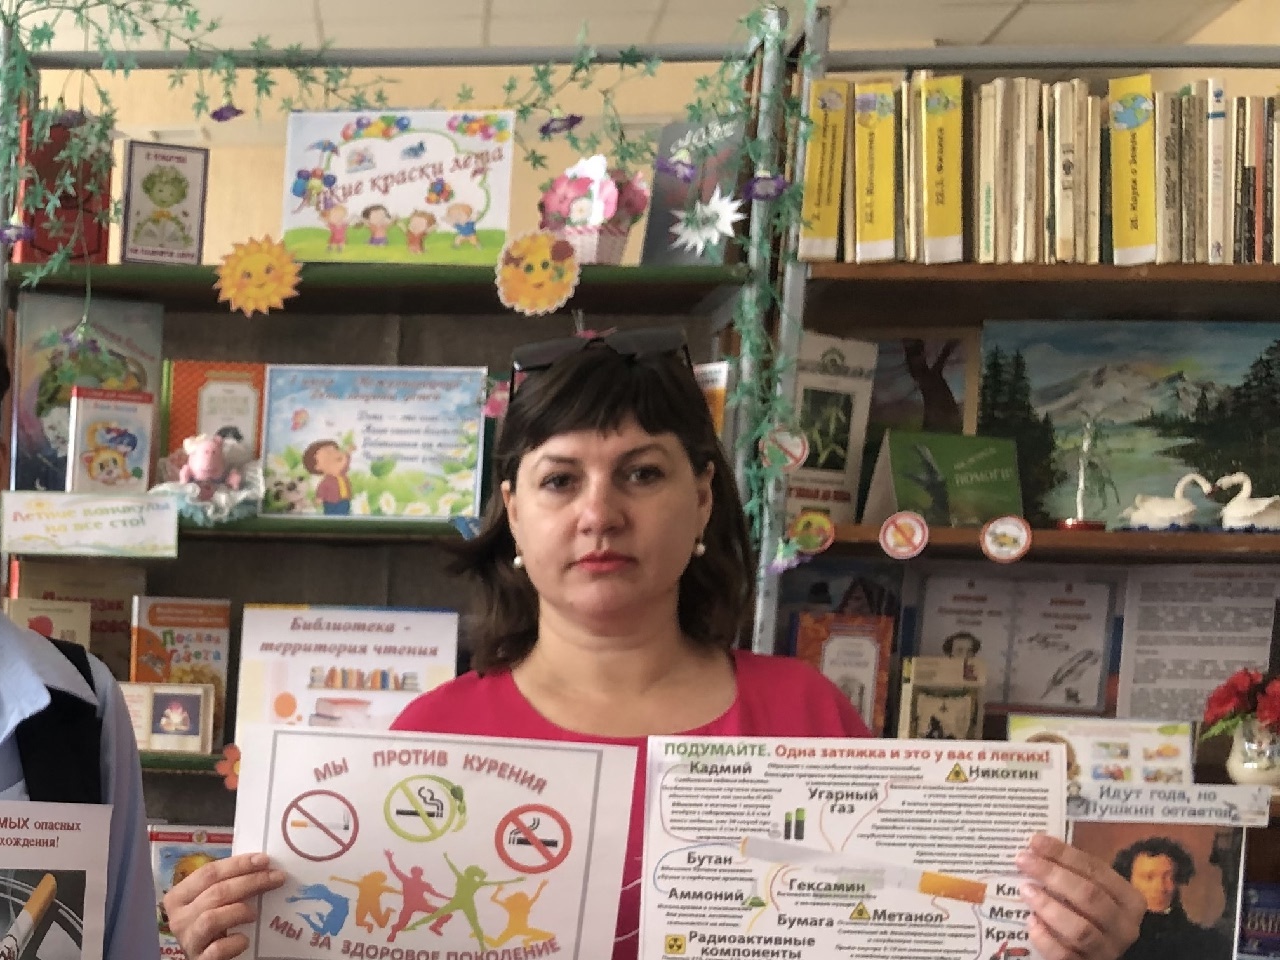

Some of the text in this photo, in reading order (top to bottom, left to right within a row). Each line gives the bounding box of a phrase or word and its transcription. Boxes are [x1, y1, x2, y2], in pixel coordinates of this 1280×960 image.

[370, 162, 444, 195] краски
[290, 617, 396, 634] Библиотека
[258, 640, 439, 658] территория чтения
[664, 741, 1051, 764] ПОДУМАЙТЕ. Одна затяжка и это у вас в легких!
[313, 749, 548, 795] МЫ ПРОТИВ КУРЕНИЯ
[689, 761, 753, 776] Кадмий
[969, 765, 1039, 780] Никотин
[808, 787, 879, 803] Угарный
[1100, 785, 1217, 803] Идут года, но
[829, 803, 855, 815] газ
[34, 820, 82, 832] опасных
[687, 852, 733, 867] Бутан
[789, 880, 866, 893] Гексамин
[668, 888, 745, 903] Аммоний
[872, 909, 943, 923] Метанол
[989, 906, 1032, 919] Мета
[777, 914, 834, 929] Бумага
[309, 932, 331, 951] ЗА
[688, 932, 816, 947] Радиоактивные
[701, 946, 802, 959] компоненты
